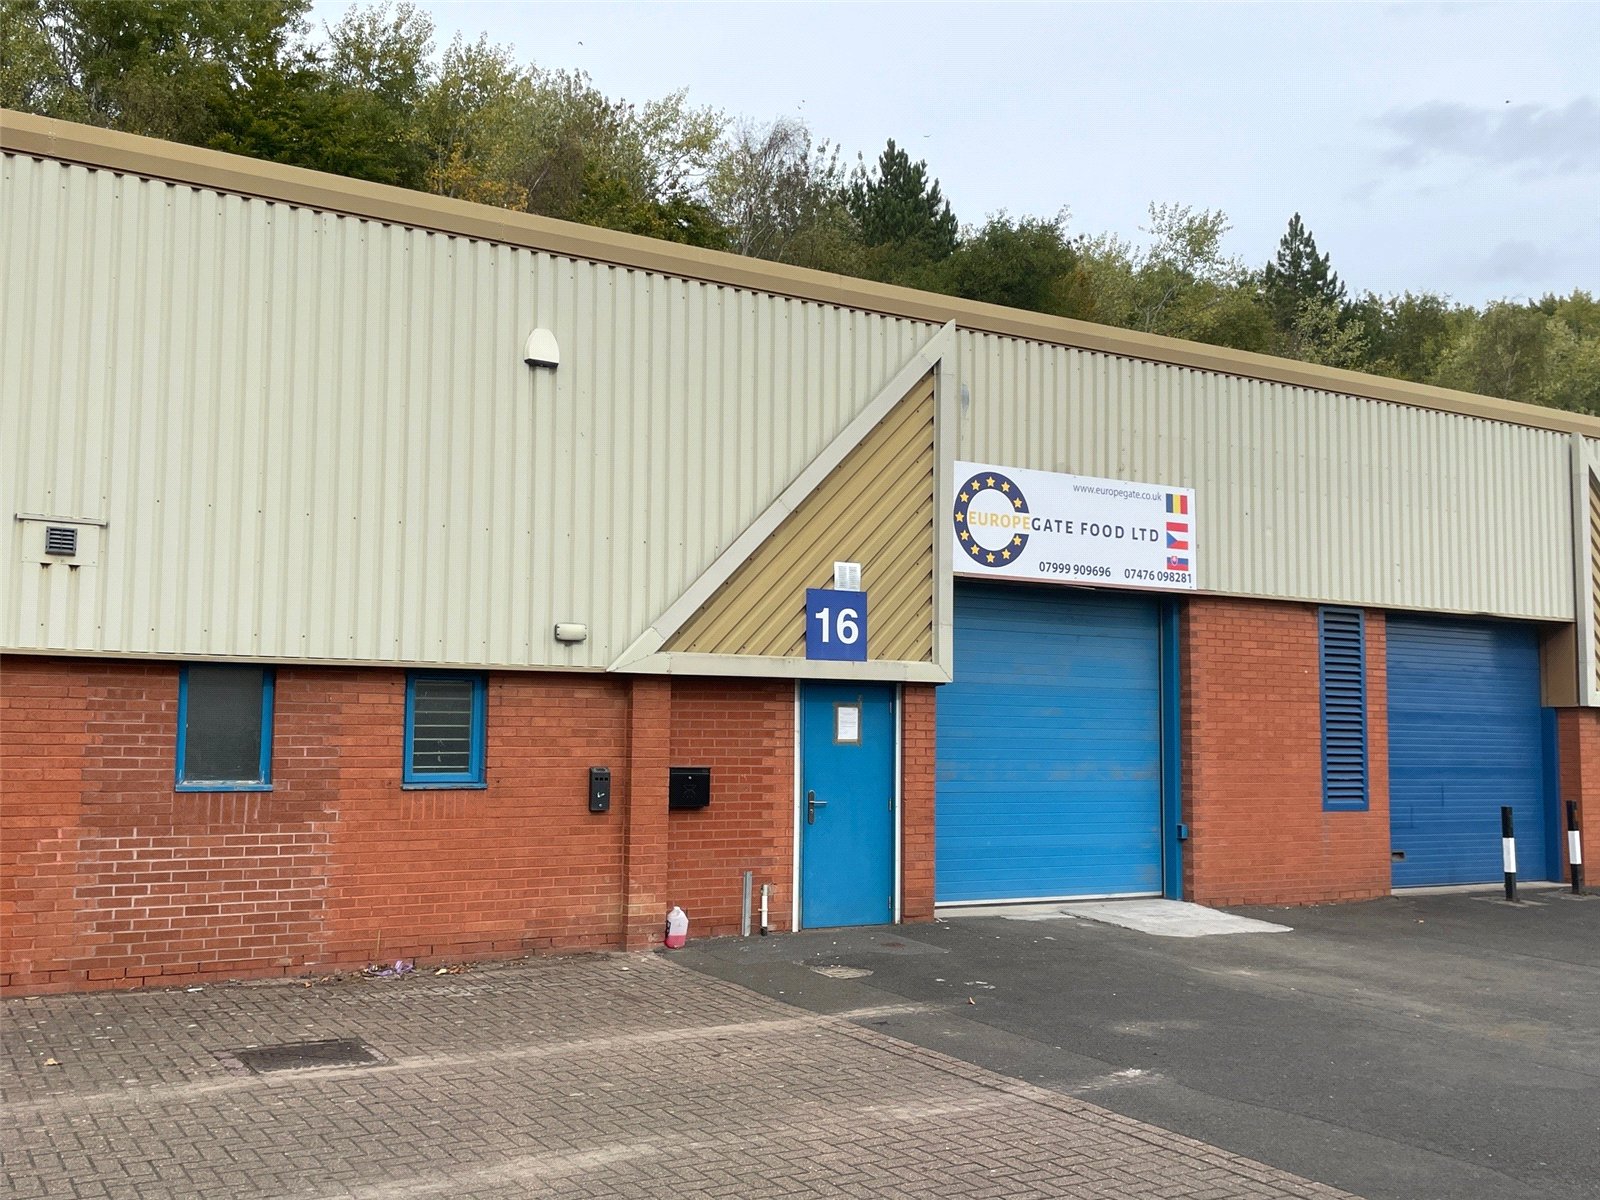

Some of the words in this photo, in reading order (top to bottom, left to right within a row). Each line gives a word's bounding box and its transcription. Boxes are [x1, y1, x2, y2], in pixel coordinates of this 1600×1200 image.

[1073, 484, 1162, 501] www.europegate.co.uk
[1081, 522, 1125, 539] FOOD
[1132, 527, 1159, 542] LTD
[1039, 561, 1071, 574] 07999
[1073, 564, 1111, 577] 909696
[1124, 568, 1155, 581] 07476
[1157, 571, 1192, 583] 098281
[815, 607, 859, 645] 16
